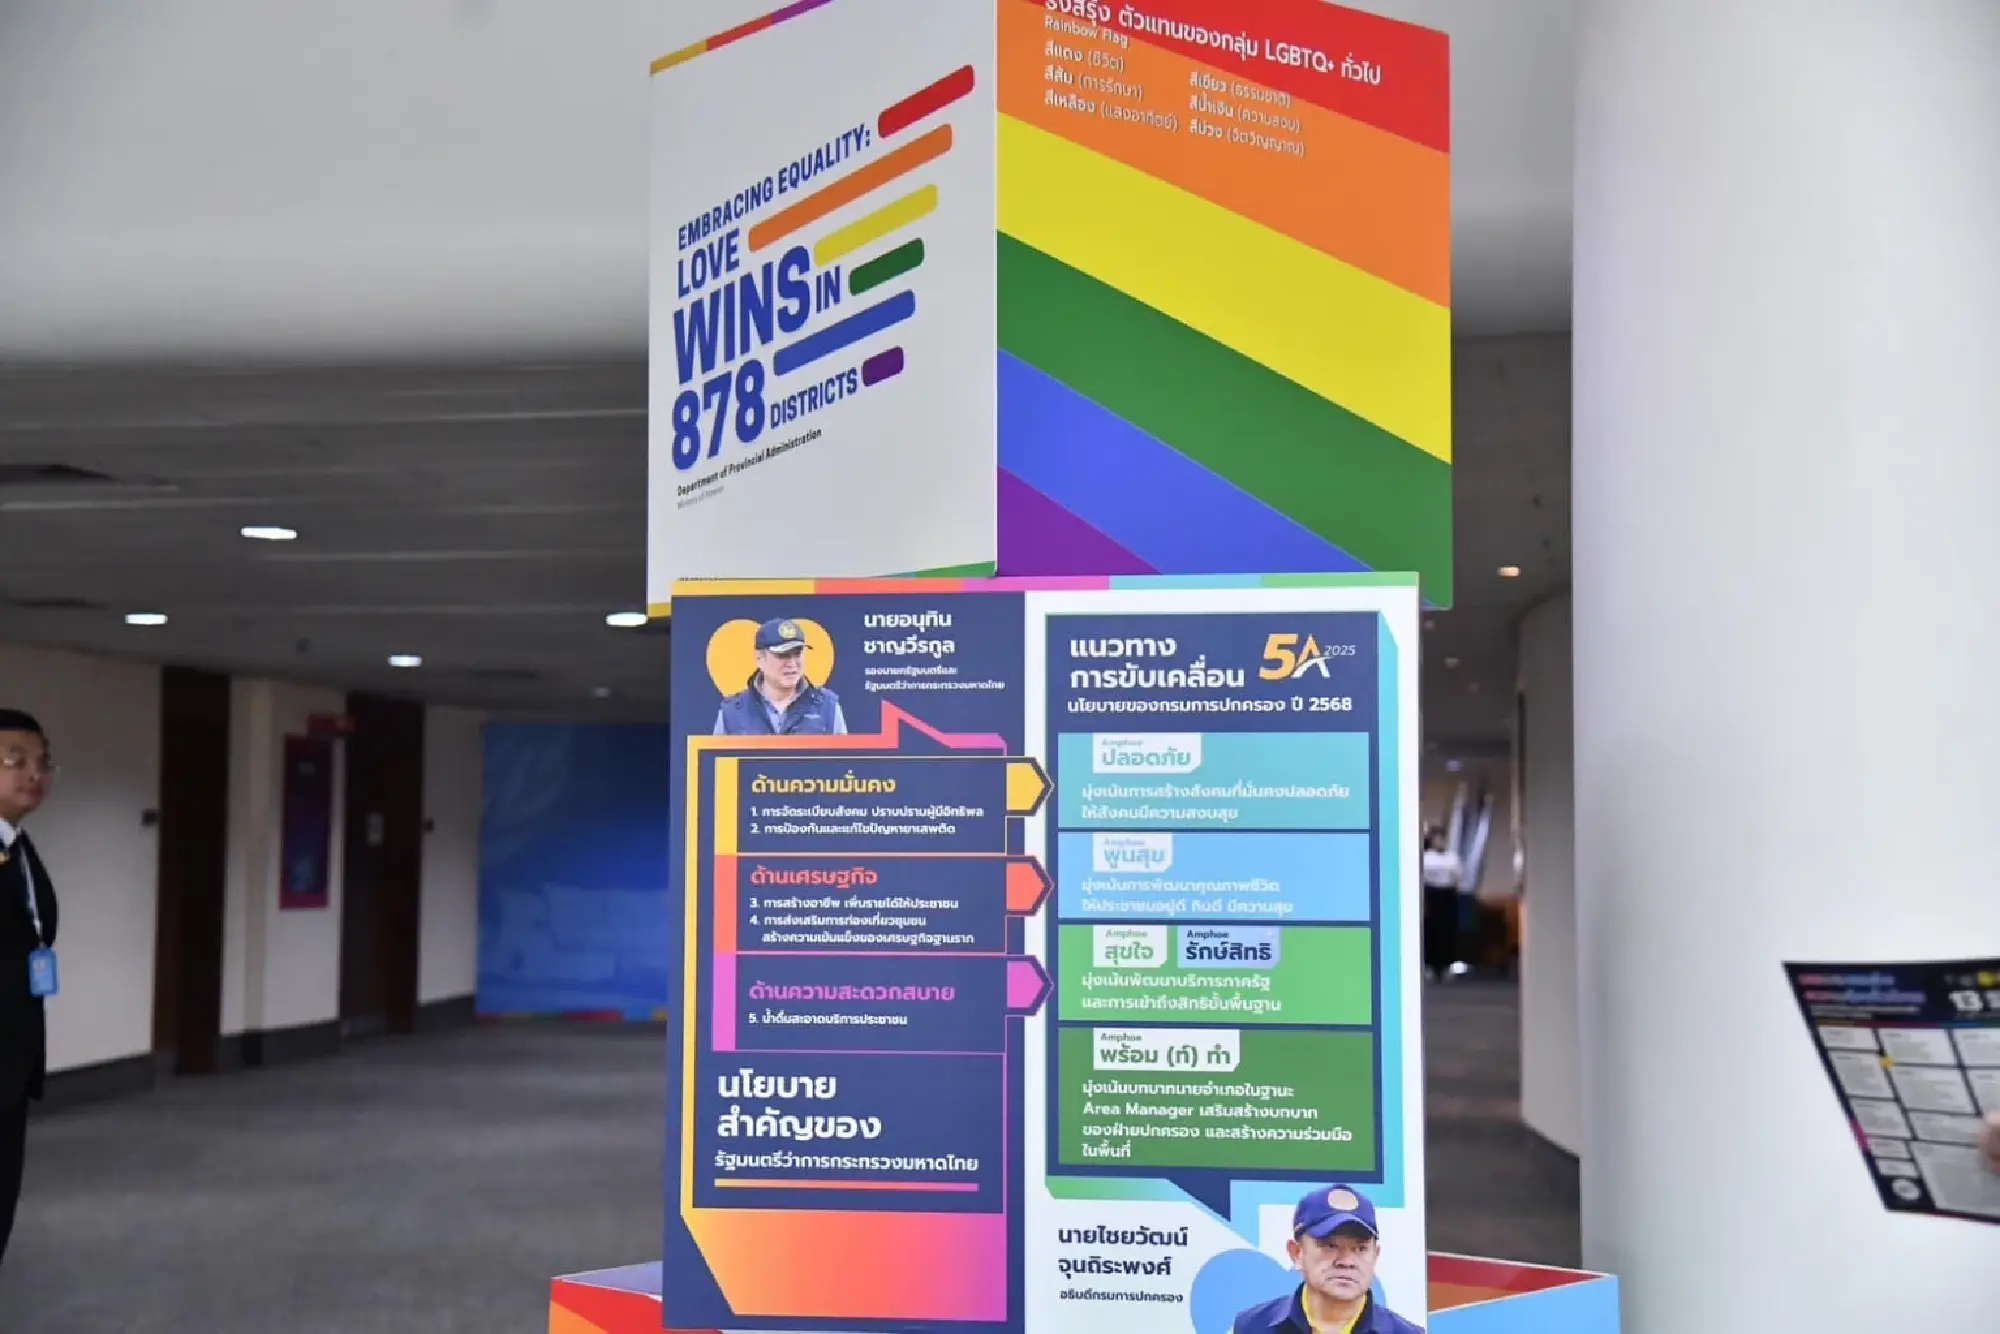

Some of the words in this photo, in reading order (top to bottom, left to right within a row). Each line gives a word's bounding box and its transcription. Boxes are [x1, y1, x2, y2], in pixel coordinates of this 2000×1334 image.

[1044, 14, 1099, 39] Rainbow
[1103, 27, 1129, 49] Flag
[1118, 4, 1258, 61] ตัวแทนของกลุ่ม
[1264, 39, 1334, 73] LGBTQ+
[1340, 52, 1382, 86] ทั่วไป
[677, 176, 773, 251] EMBRACING
[777, 123, 871, 195] EQUALITY:
[677, 228, 740, 298] LOVE
[673, 245, 811, 385] WINS
[816, 265, 841, 314] IN
[671, 359, 765, 471] 878
[770, 367, 858, 430] DISTRICTS
[677, 471, 718, 497] Department
[728, 449, 764, 475] Provincial
[765, 428, 822, 460] Administration
[864, 610, 952, 633] นายอนุทิน
[864, 634, 956, 659] ชาญวีรกูล
[1070, 636, 1178, 659] แนวทาง
[1323, 644, 1357, 657] 2025
[1070, 654, 1246, 690] การขับเคลื่อน
[1067, 696, 1286, 714] นโยบายของกรมการปกครอง
[1291, 694, 1304, 712] ปี
[1308, 696, 1353, 712] 2568
[1101, 747, 1192, 767] ปลอดภัย
[751, 769, 897, 794] ด้านความมั่นคง
[1104, 848, 1165, 869] พูนสุข
[751, 865, 879, 889] ด้านเศรษฐกิจ
[749, 897, 760, 909] 3.
[764, 896, 841, 909] การสร้างอาชีพ
[749, 914, 760, 926] 4.
[1186, 929, 1230, 940] Amphoe
[1105, 941, 1154, 965] สุขใจ
[1185, 941, 1273, 961] รักษ์สิทธิ
[749, 980, 956, 1001] ด้านความสะดวกสบาย
[748, 1013, 758, 1024] 5.
[1100, 1043, 1158, 1063] พร้อม
[1207, 1043, 1231, 1064] ทำ
[717, 1067, 837, 1099] นโยบาย
[717, 1104, 882, 1140] สำคัญของ
[1083, 1102, 1121, 1116] Area
[1125, 1102, 1194, 1120] Manager
[1199, 1102, 1318, 1119] เสริมสร้างบทบาท
[1082, 1122, 1200, 1138] ของฝ่ายปกครอง
[1082, 1139, 1131, 1158] ในพื้นที่
[714, 1152, 979, 1172] รัฐมนตรีว่าการกระทรวงมหาดไทย
[1058, 1225, 1189, 1246] นายไชยวัฒน์
[1058, 1255, 1172, 1280] จุนถิระพงศ์
[1060, 1287, 1184, 1304] อธิบดีกรมการปกครอง
